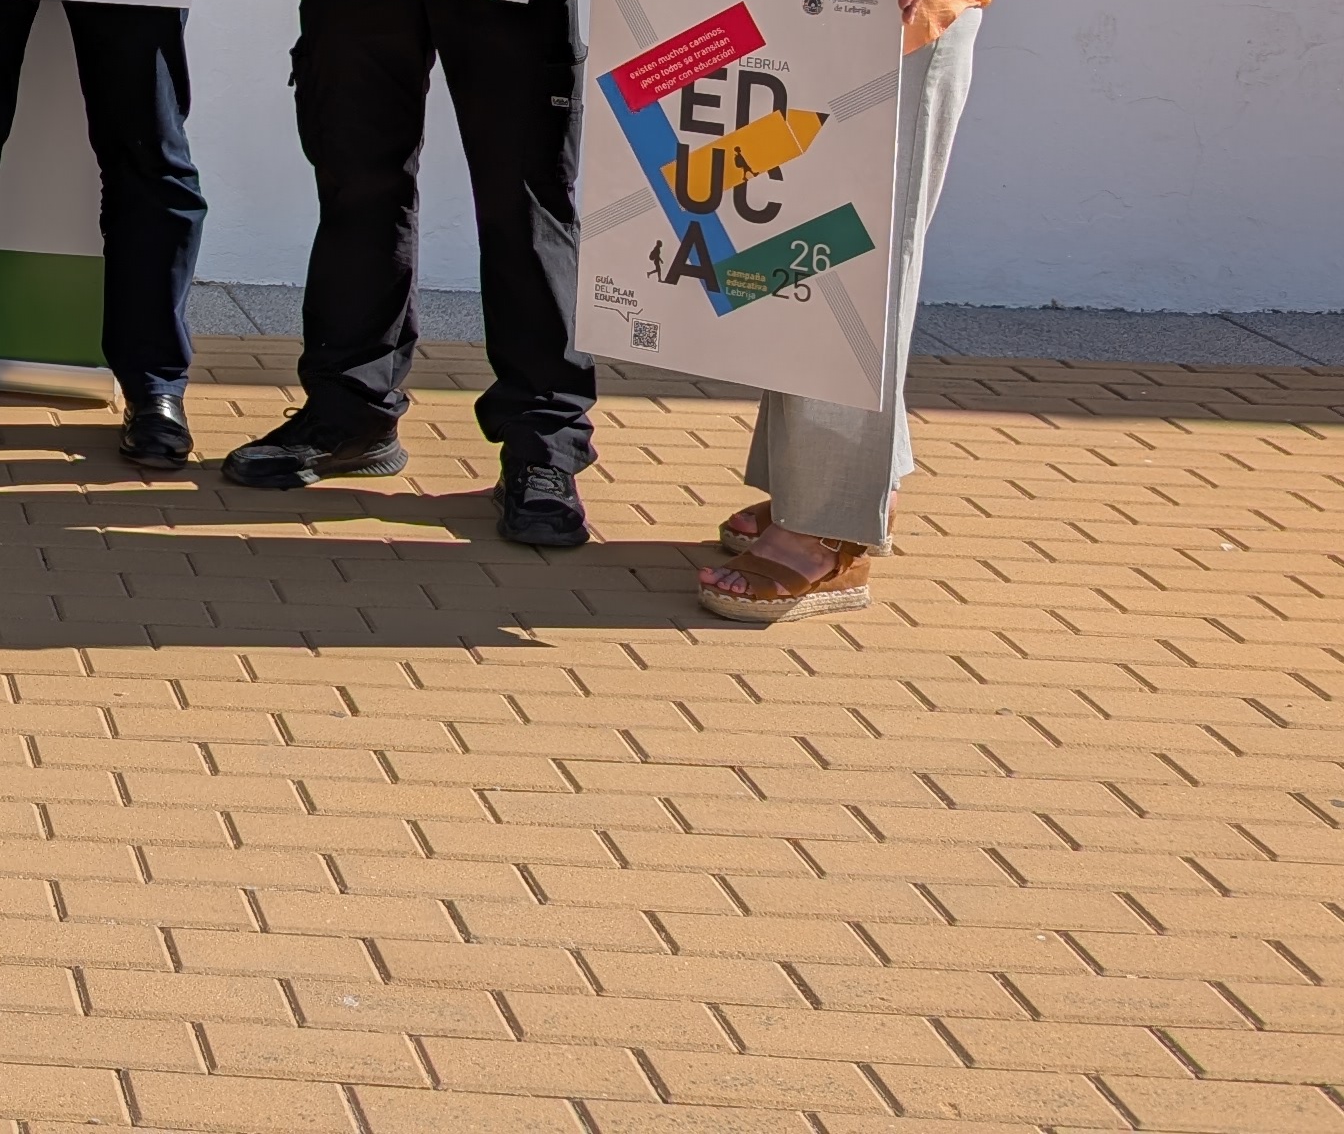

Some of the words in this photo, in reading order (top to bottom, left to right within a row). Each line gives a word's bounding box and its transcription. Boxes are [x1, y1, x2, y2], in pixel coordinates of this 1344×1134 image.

[738, 56, 790, 73] LEBRIJA
[664, 221, 721, 293] A
[789, 241, 832, 272] 26
[772, 268, 811, 302] 25
